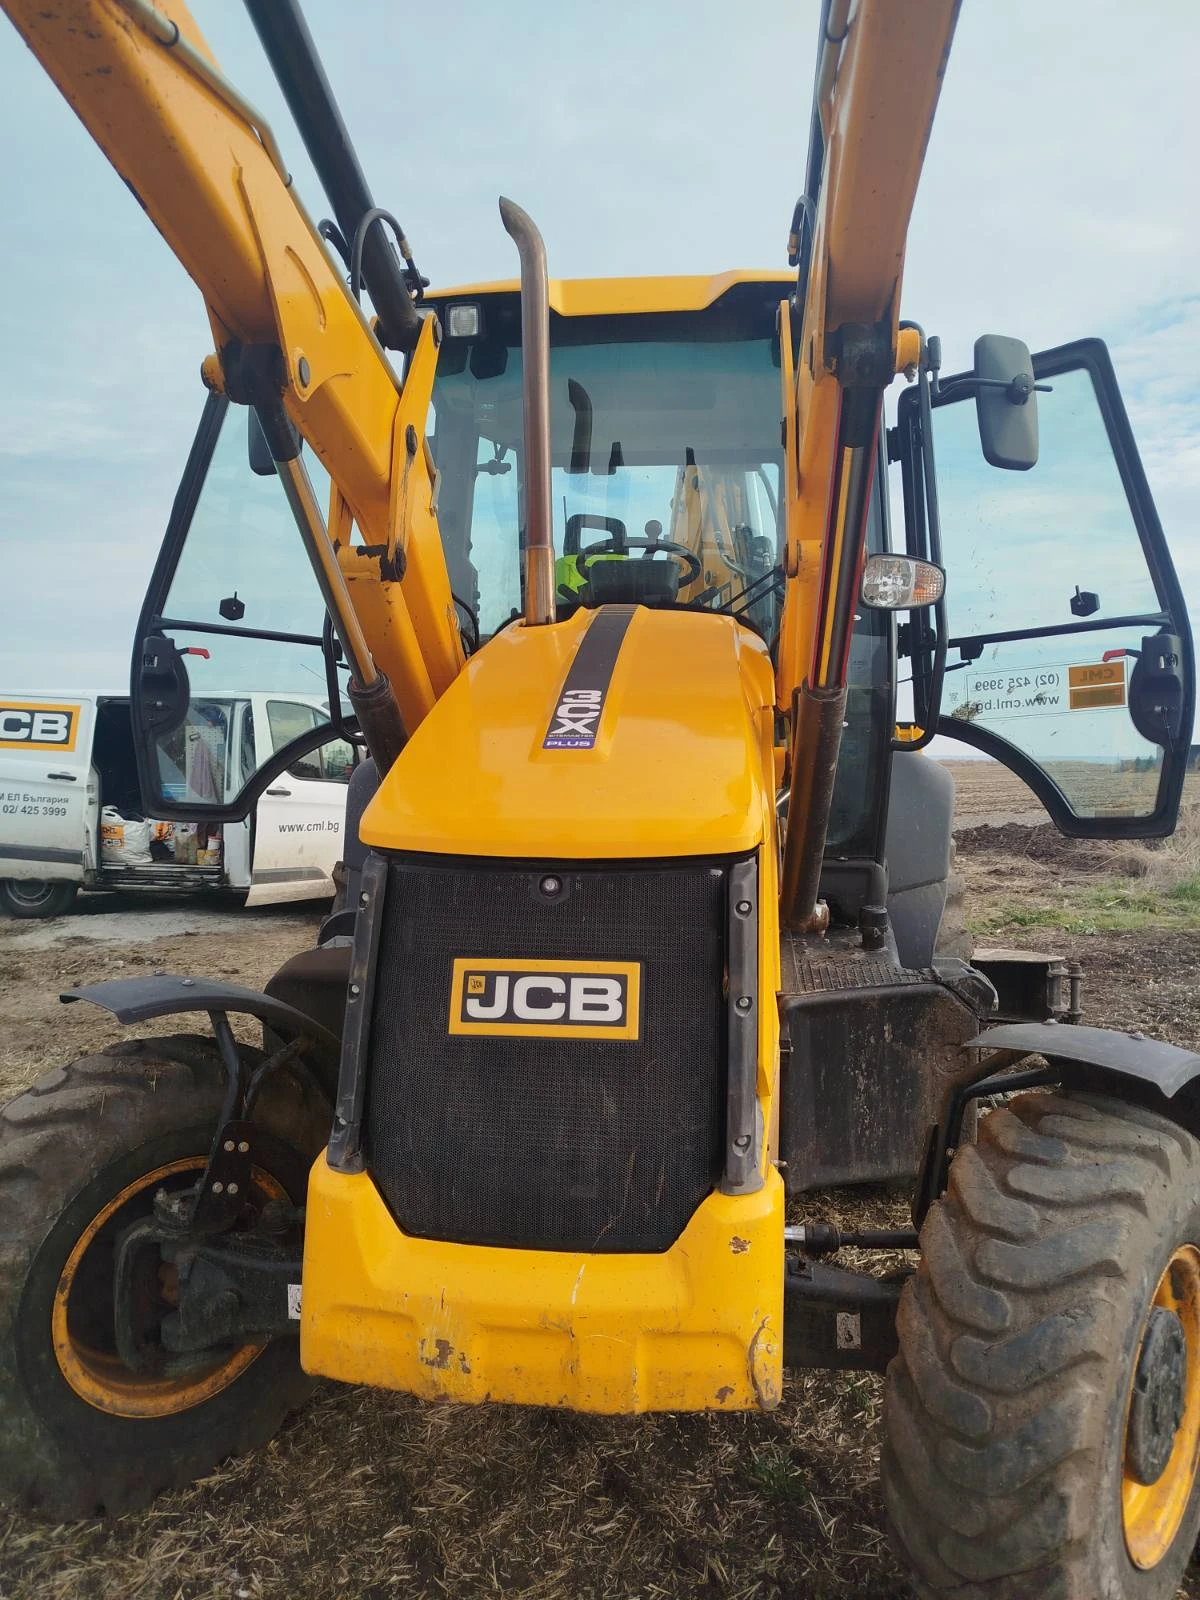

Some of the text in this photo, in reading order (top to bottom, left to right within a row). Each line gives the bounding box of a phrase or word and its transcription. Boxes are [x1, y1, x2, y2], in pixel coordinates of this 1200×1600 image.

[551, 690, 602, 734] 3CX
[20, 805, 40, 815] 425
[42, 806, 67, 817] 3999
[278, 820, 340, 833] www.cml.bg
[466, 975, 623, 1022] JCB
